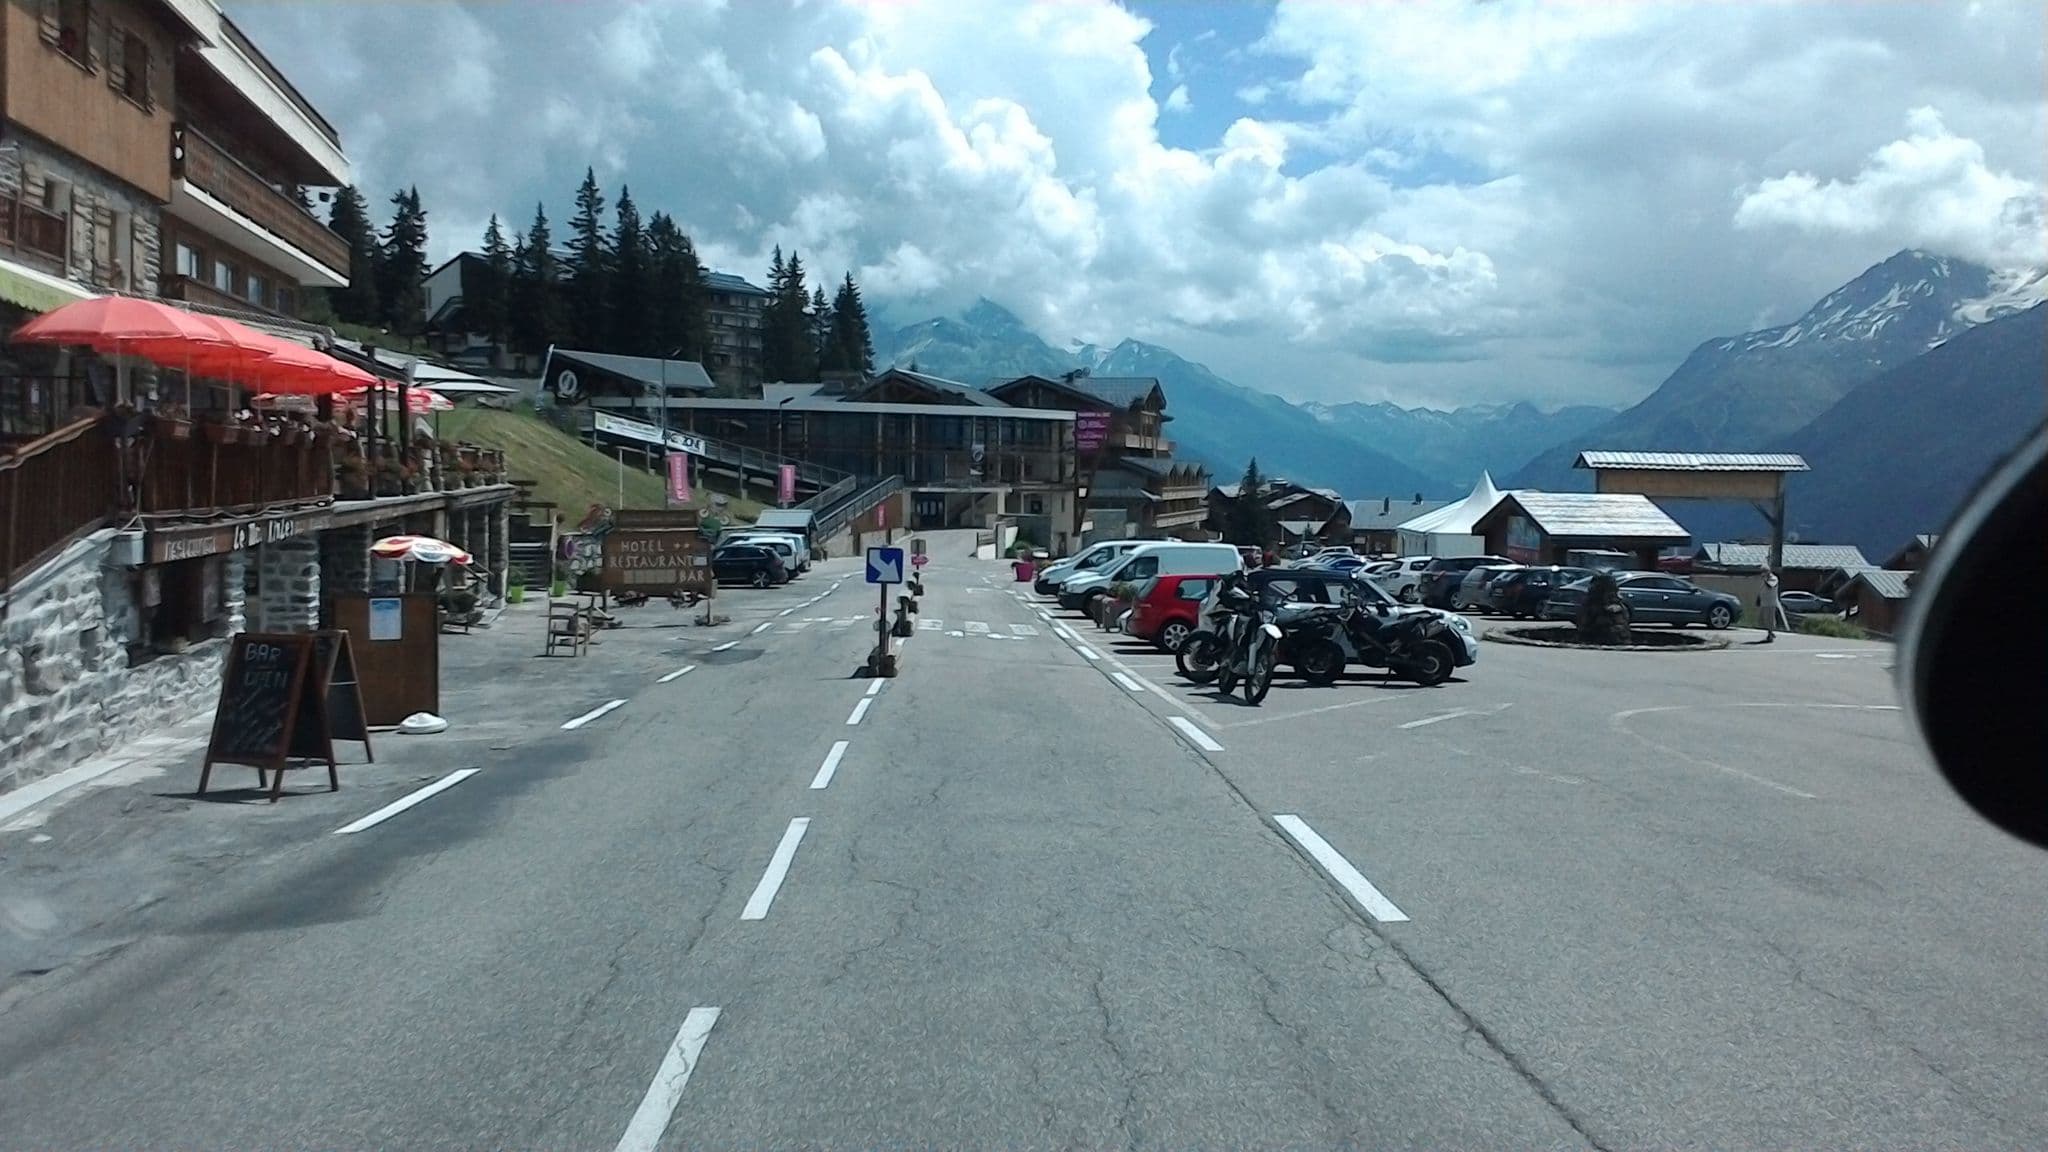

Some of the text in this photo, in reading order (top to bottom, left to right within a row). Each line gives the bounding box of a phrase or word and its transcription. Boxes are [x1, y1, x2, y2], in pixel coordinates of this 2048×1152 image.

[621, 540, 665, 553] HOTEL
[609, 555, 694, 568] RESTAURANT
[678, 570, 705, 583] BAR
[245, 642, 282, 663] BAR
